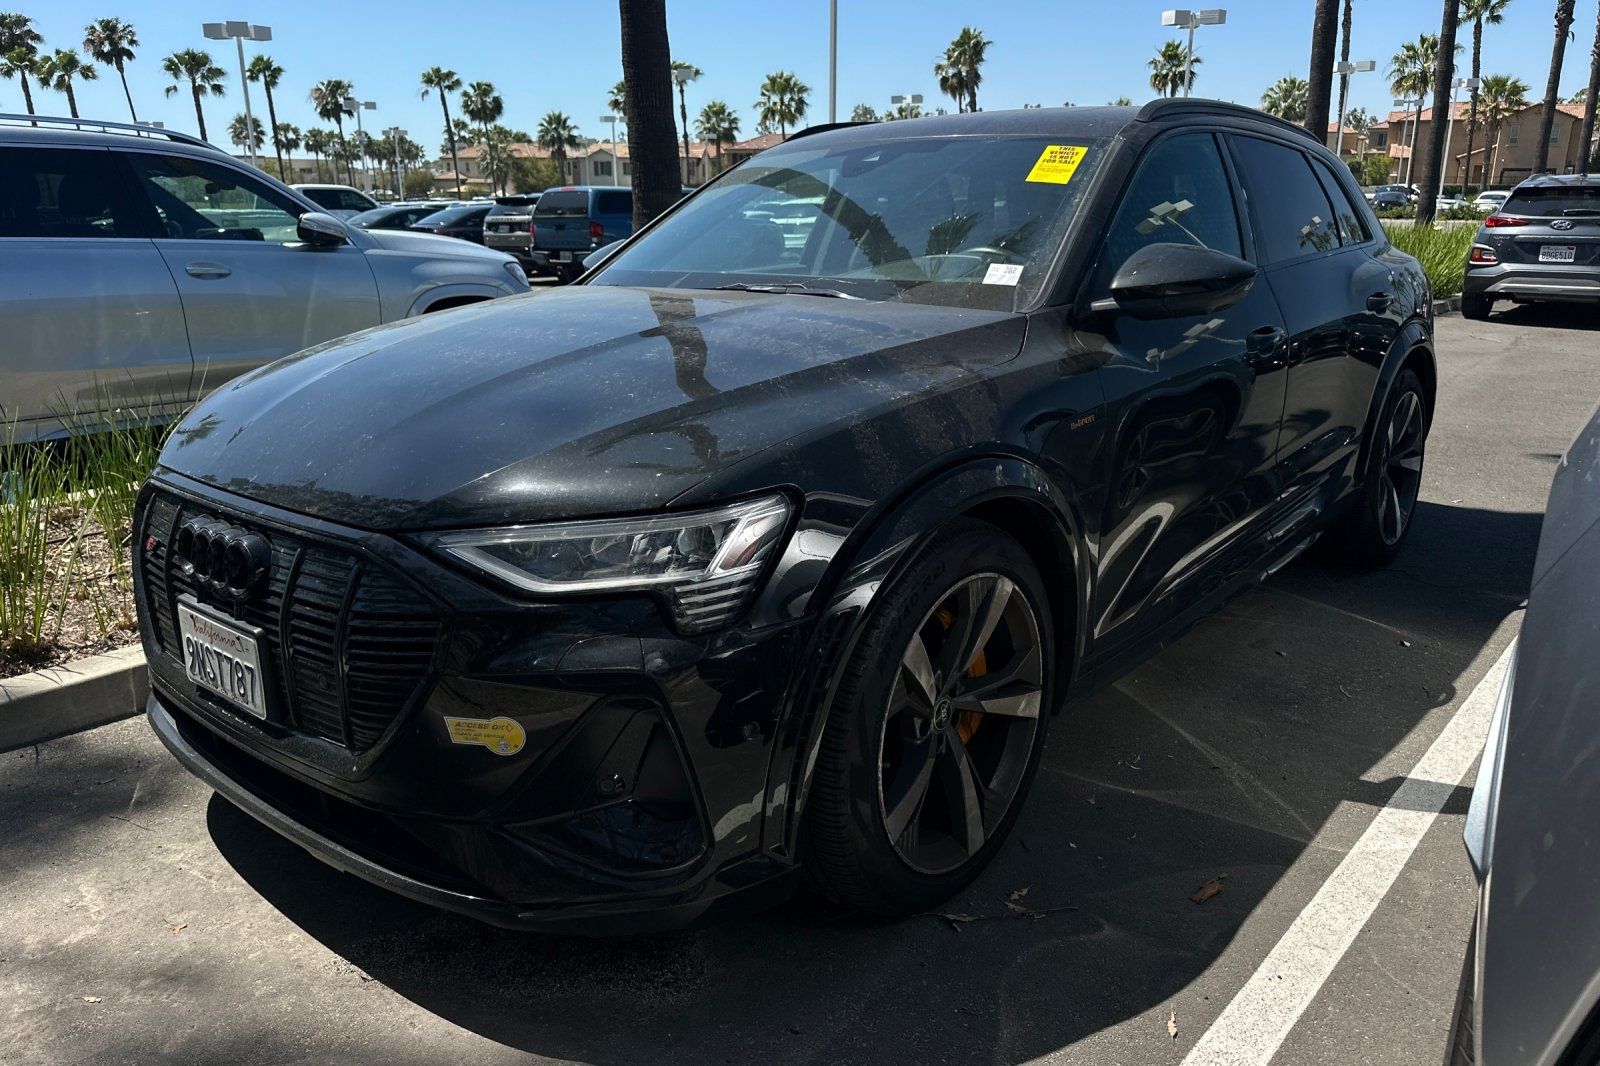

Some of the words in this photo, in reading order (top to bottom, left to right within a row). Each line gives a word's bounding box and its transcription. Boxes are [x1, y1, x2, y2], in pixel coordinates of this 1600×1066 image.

[193, 617, 242, 652] California
[186, 636, 257, 709] 9NST787
[454, 722, 489, 730] ACCESS
